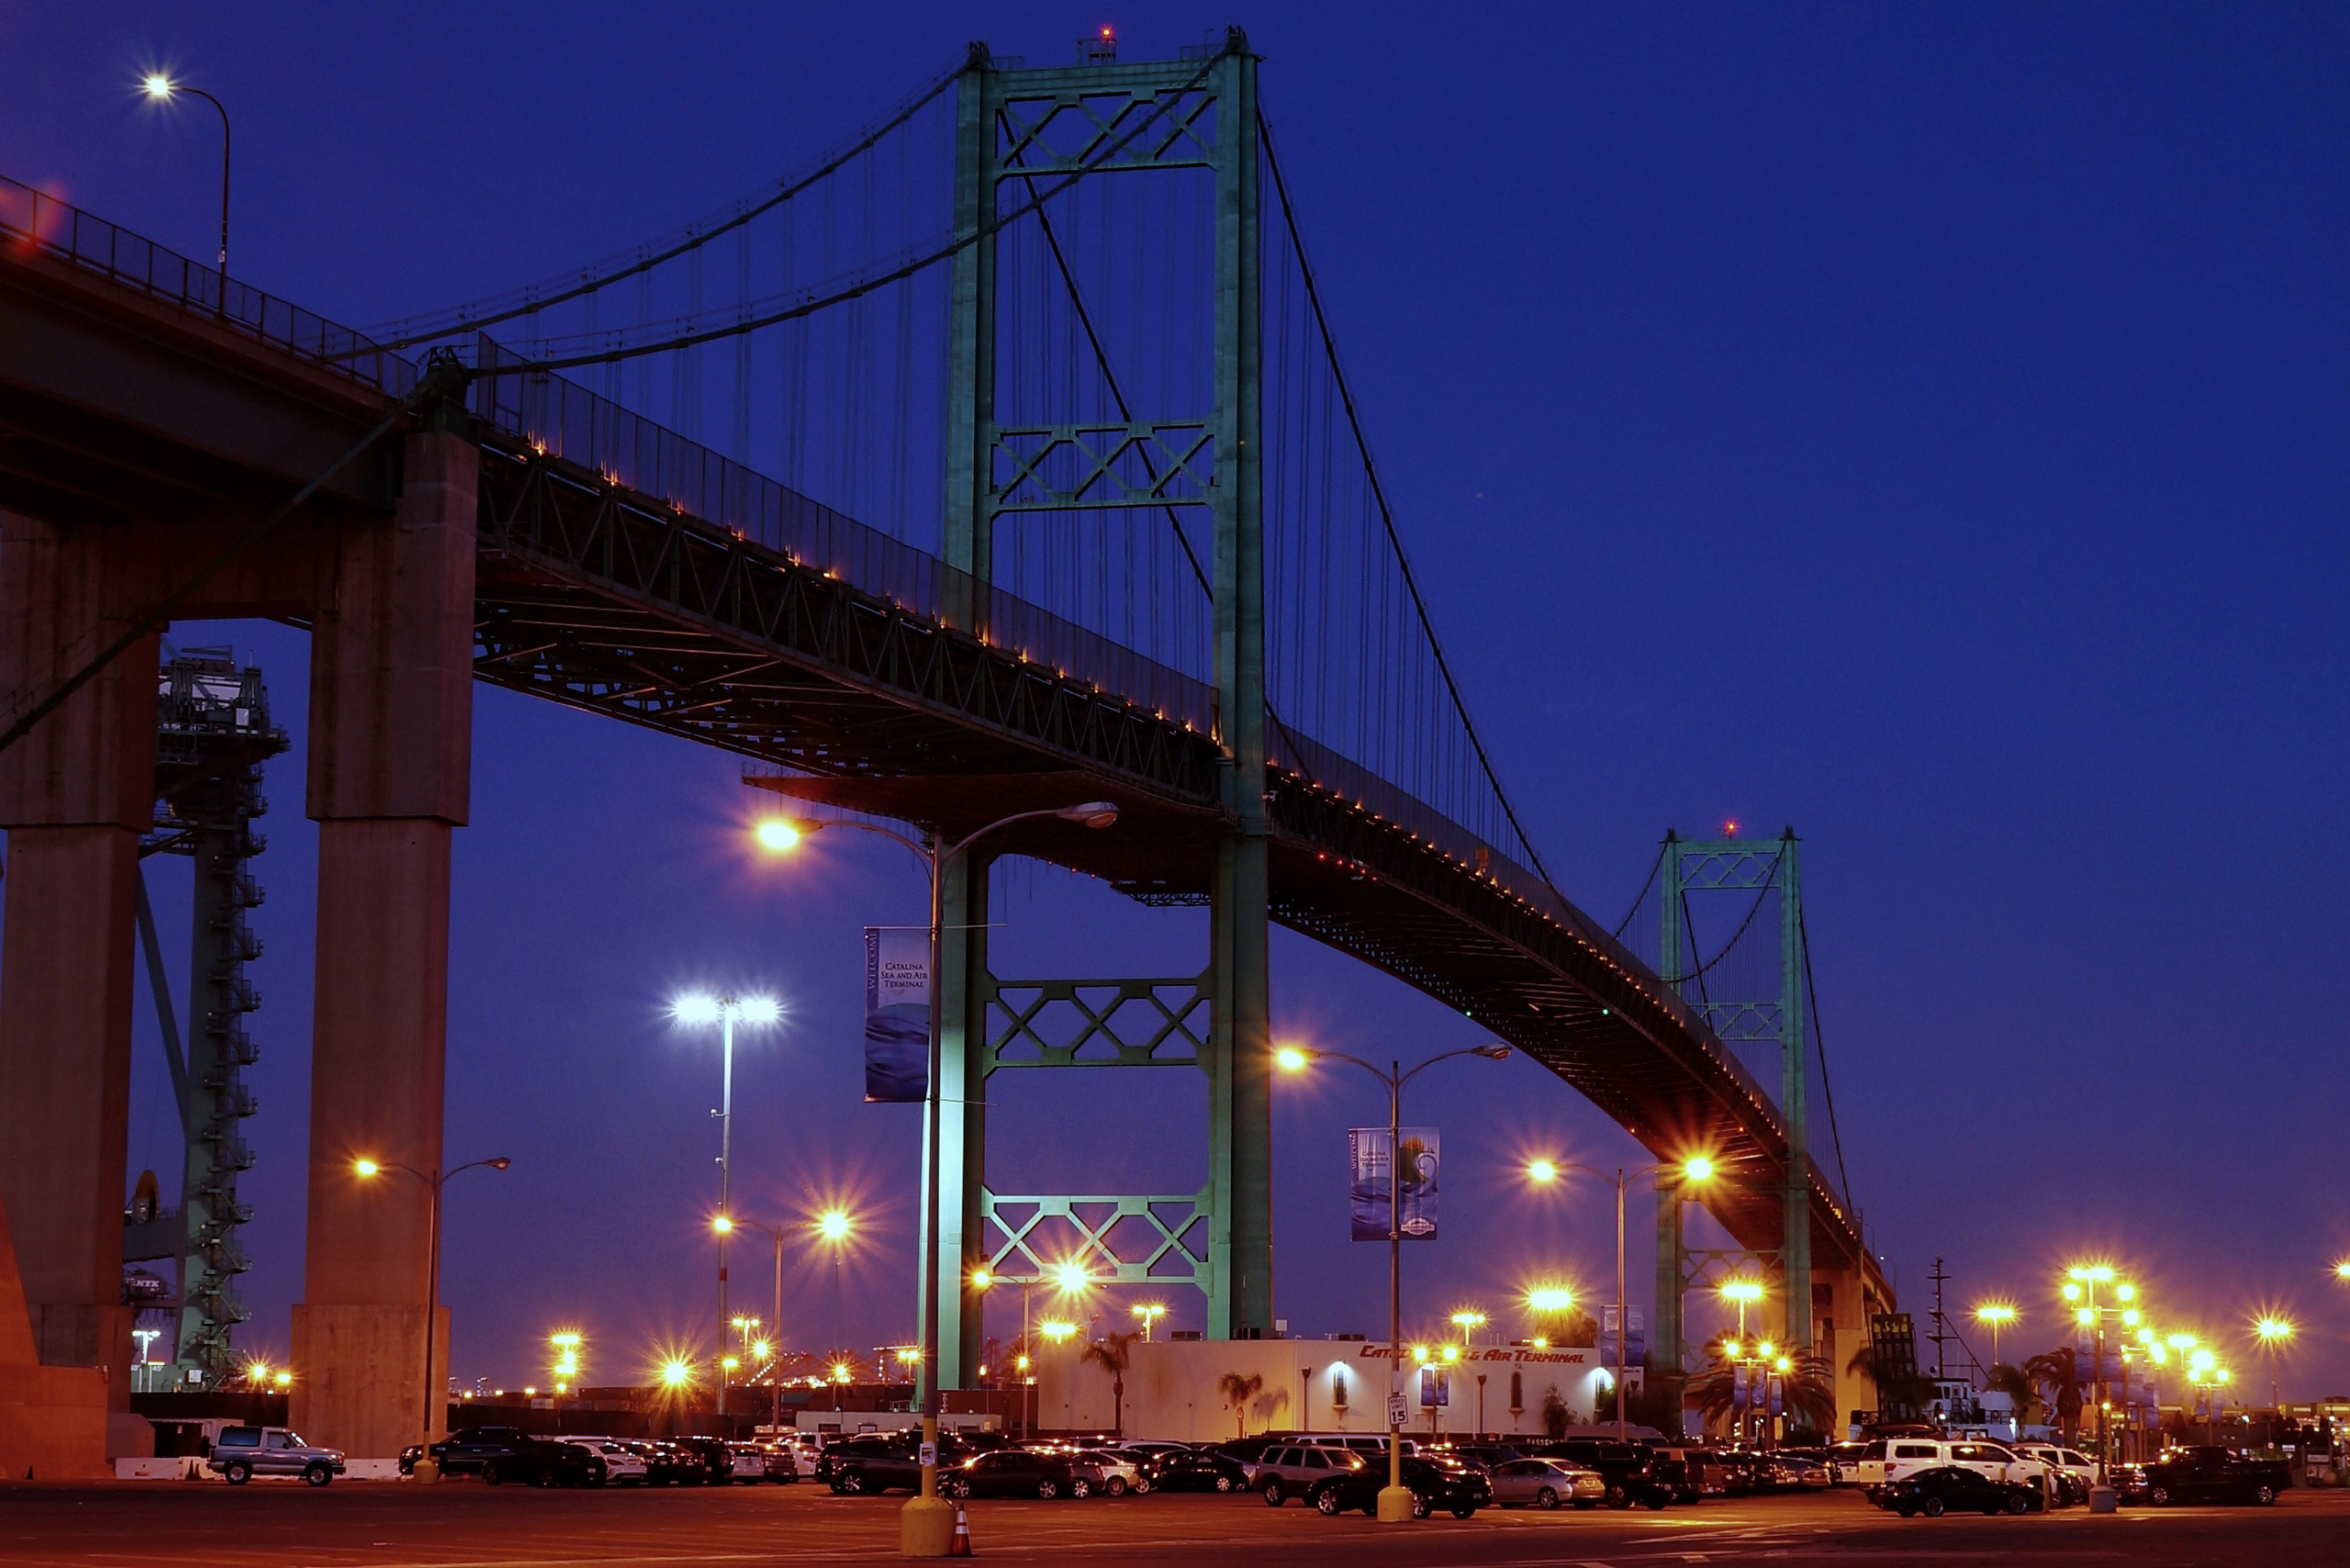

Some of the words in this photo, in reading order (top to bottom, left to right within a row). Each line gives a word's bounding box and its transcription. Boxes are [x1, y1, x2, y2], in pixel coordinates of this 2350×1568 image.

[868, 932, 877, 990] WELCOME
[885, 962, 923, 970] CATALINA
[913, 971, 928, 980] AIR
[884, 980, 923, 988] TERMINAL
[1483, 1350, 1513, 1361] AIR
[1515, 1350, 1585, 1363] TERMINAL
[1392, 1410, 1406, 1422] 15
